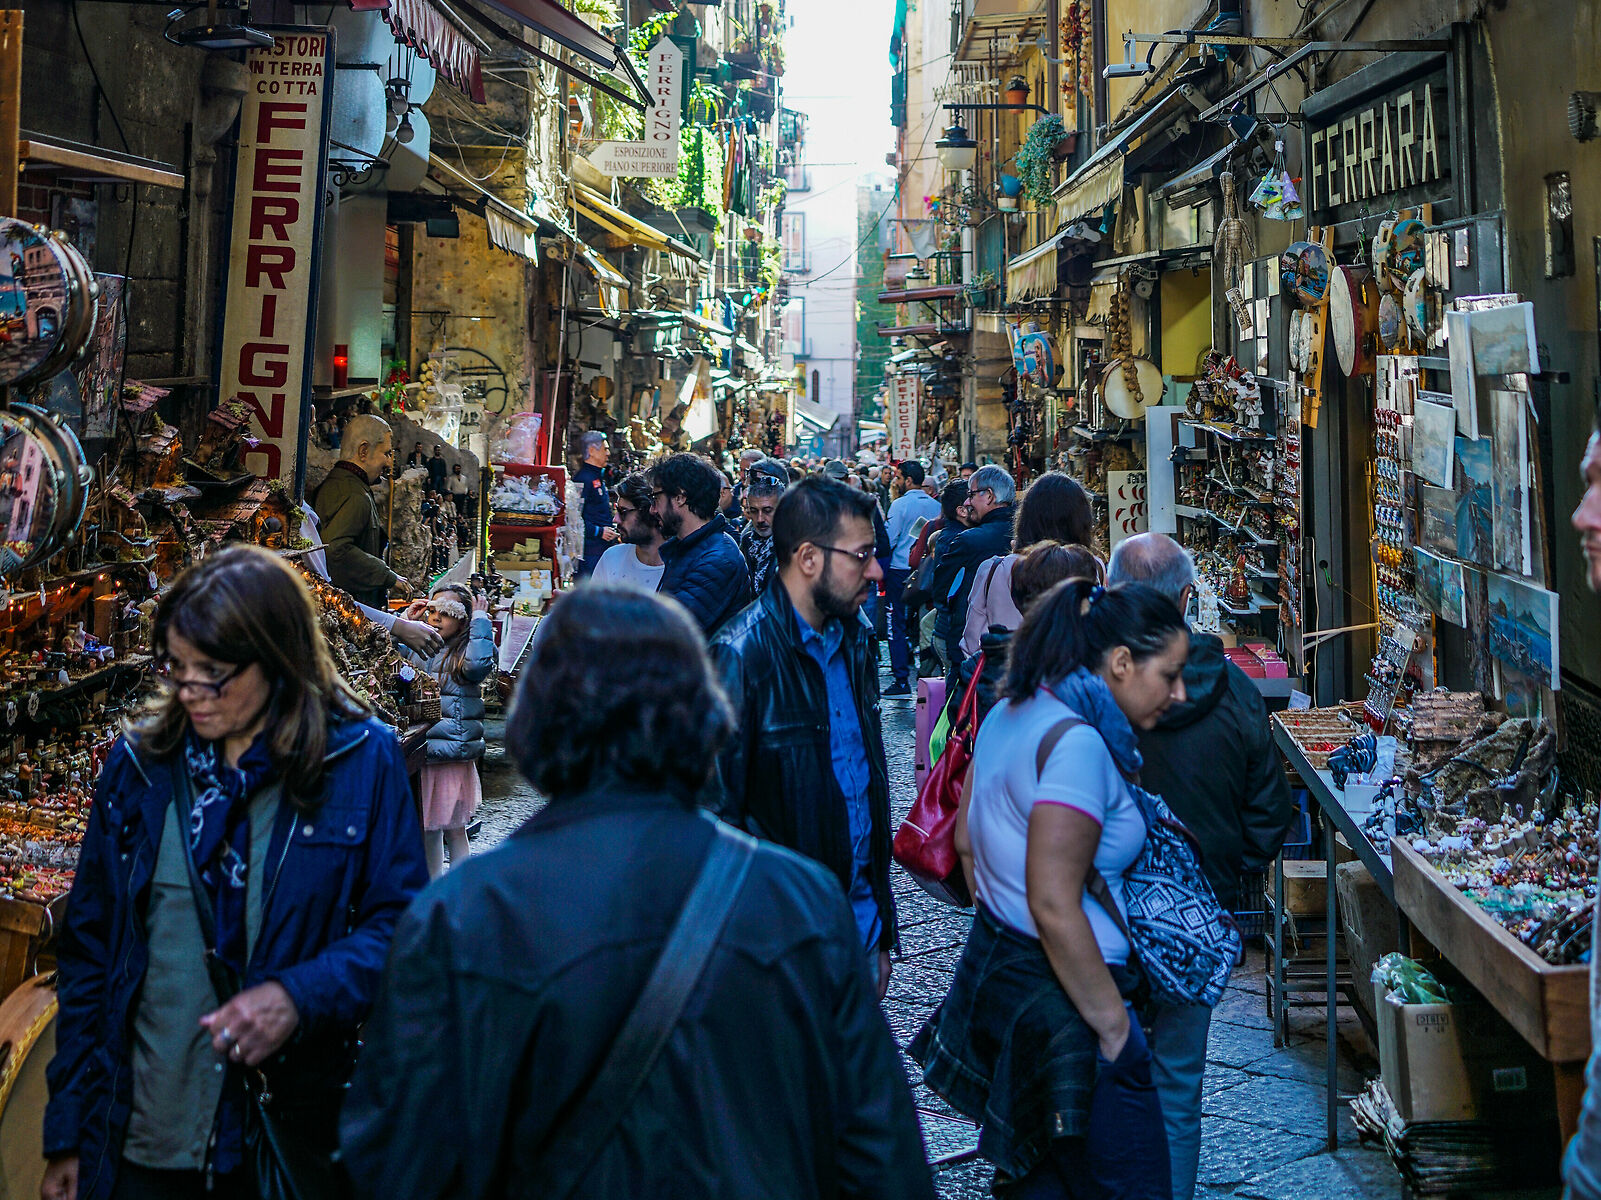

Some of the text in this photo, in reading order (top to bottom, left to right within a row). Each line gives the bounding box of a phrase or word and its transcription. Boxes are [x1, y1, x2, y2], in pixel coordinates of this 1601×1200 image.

[249, 60, 323, 76] IN TERRA
[257, 80, 317, 95] COTTA
[653, 53, 673, 142] FERRIGNO
[614, 146, 668, 158] ESPOSIZIONE
[1311, 83, 1440, 211] FERRARA
[604, 161, 676, 173] PIANO SUPERIORE
[237, 102, 308, 480] FERRIGNO
